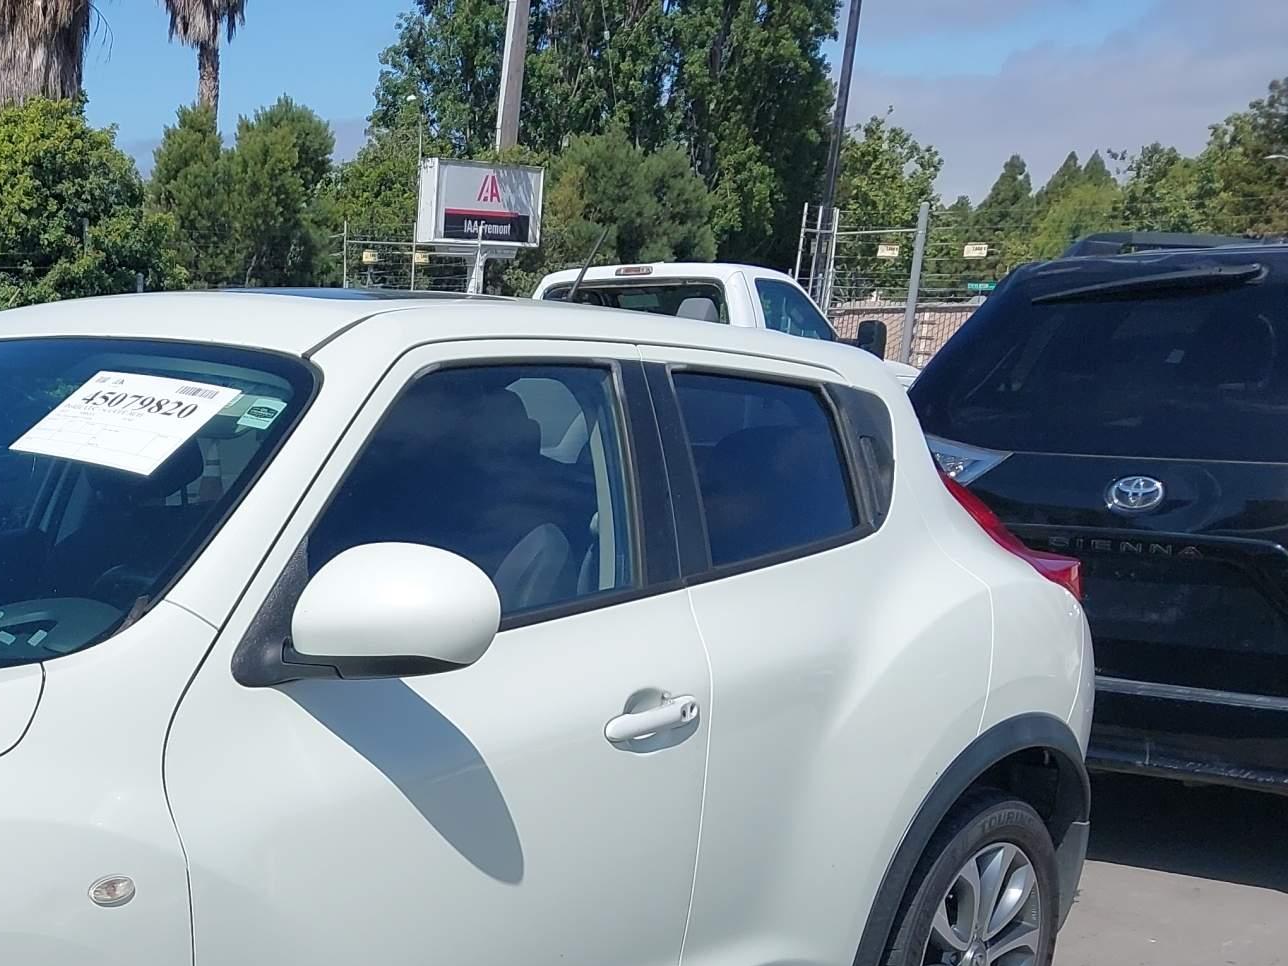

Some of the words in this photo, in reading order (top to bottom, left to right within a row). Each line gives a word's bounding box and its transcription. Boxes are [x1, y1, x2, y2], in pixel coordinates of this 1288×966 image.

[463, 219, 479, 232] IAA
[481, 220, 511, 235] Fremont
[81, 389, 199, 419] 45079820
[1047, 535, 1205, 561] SIENNA
